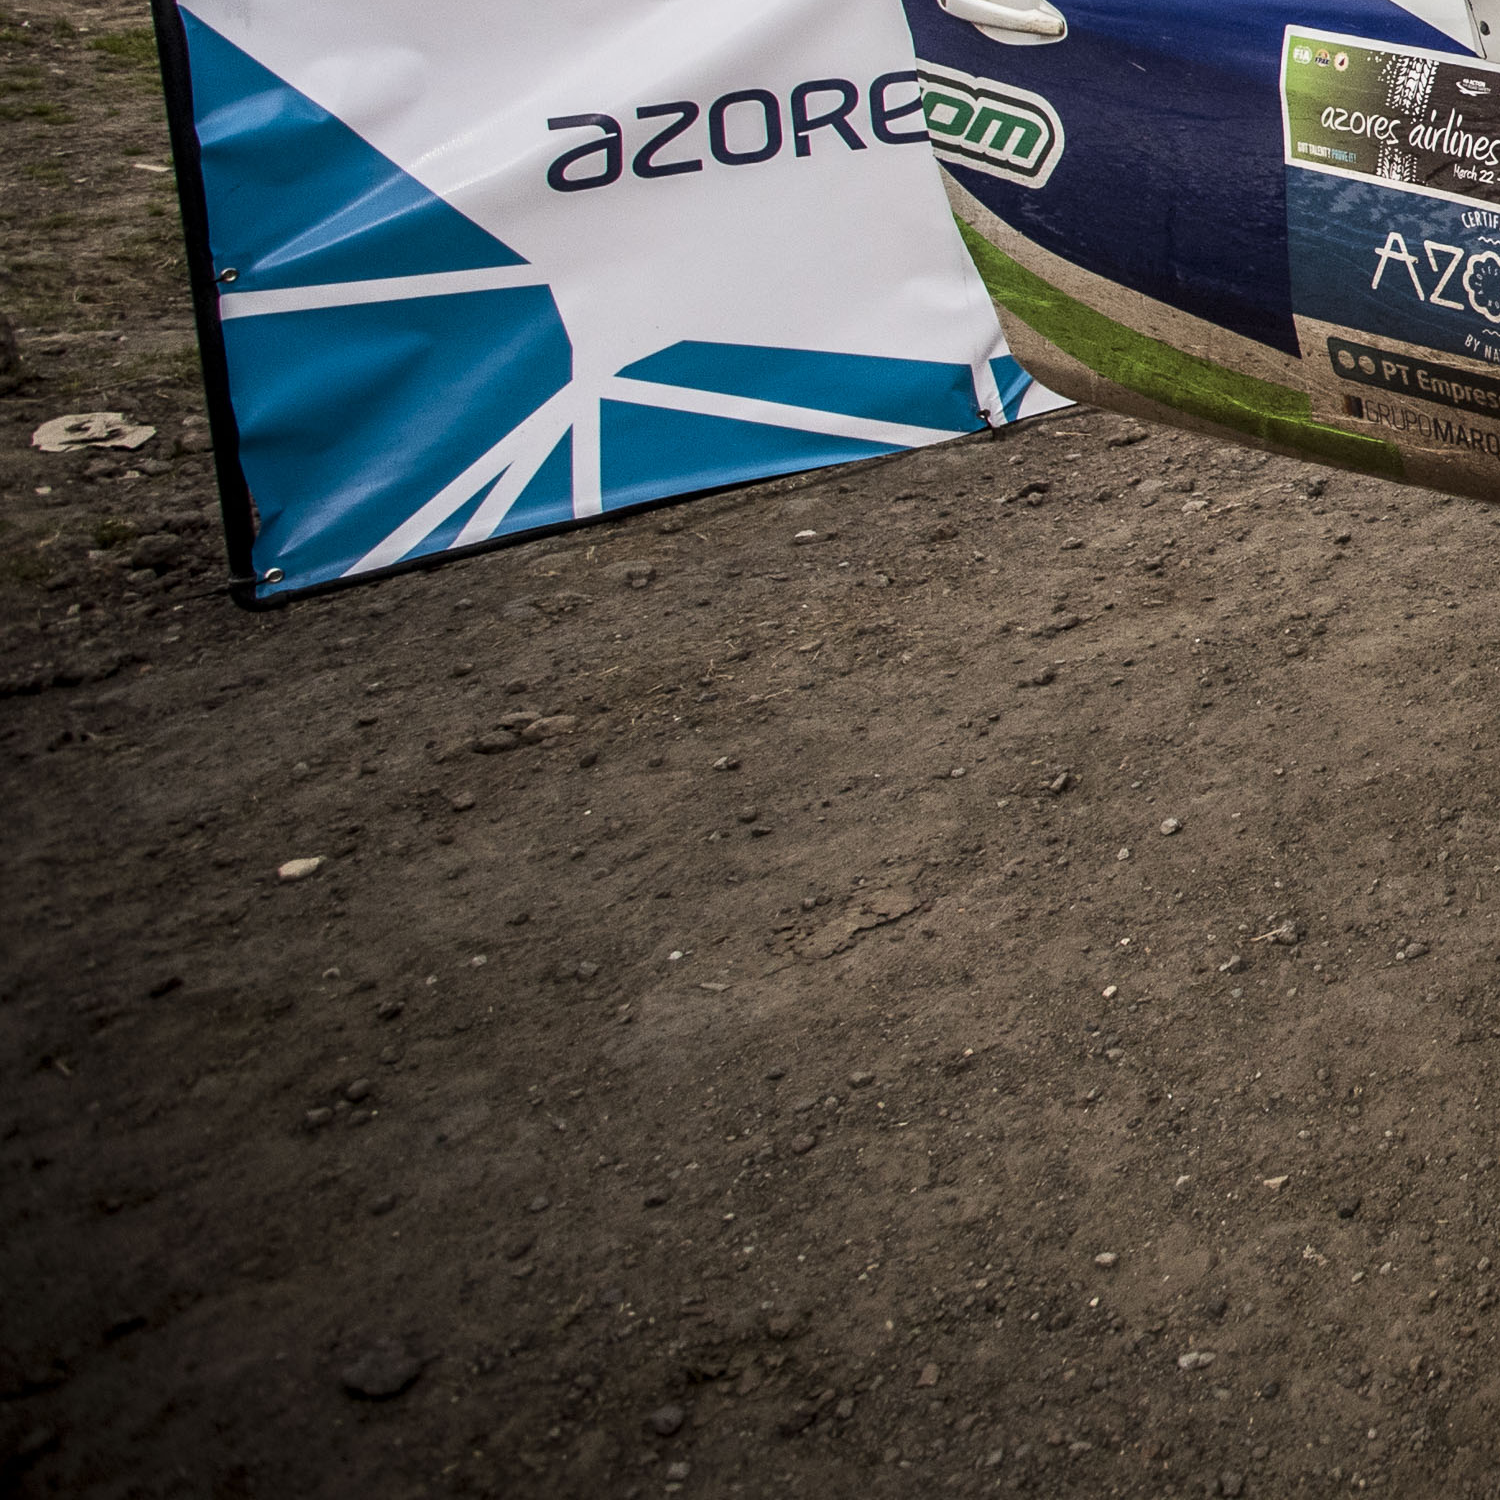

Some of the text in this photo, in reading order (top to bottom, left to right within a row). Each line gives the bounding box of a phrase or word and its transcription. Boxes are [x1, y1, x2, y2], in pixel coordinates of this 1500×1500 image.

[1320, 106, 1402, 145] azores
[1478, 169, 1495, 185] 22
[1464, 333, 1481, 352] BY
[1380, 359, 1411, 386] PT
